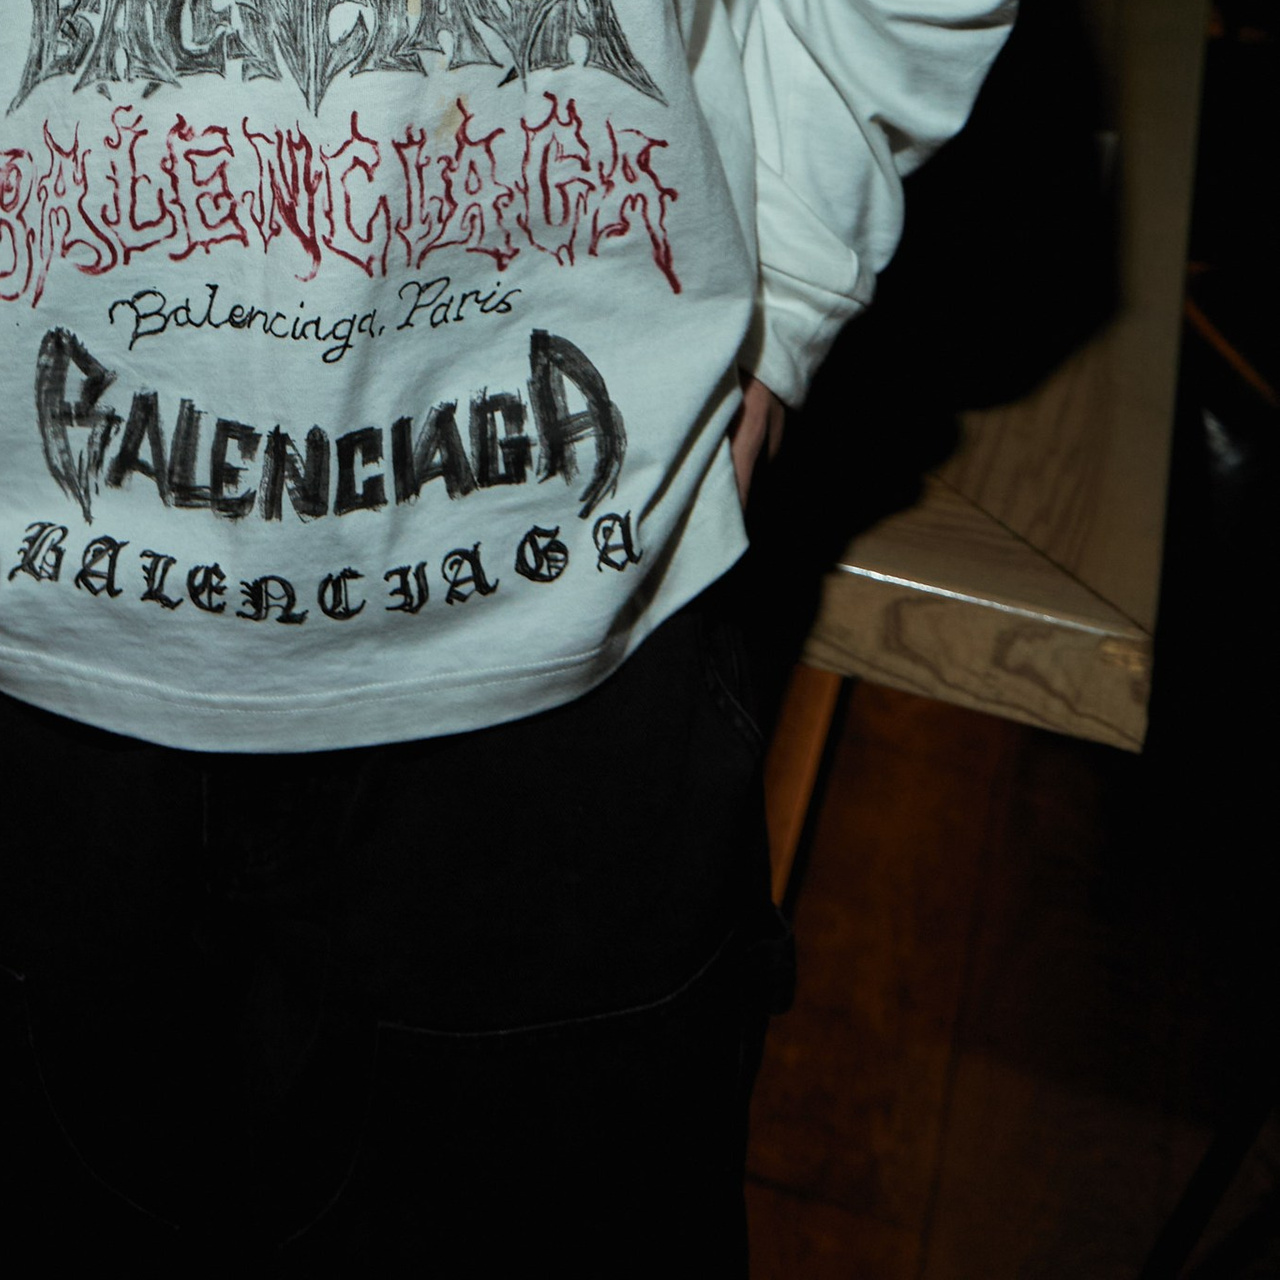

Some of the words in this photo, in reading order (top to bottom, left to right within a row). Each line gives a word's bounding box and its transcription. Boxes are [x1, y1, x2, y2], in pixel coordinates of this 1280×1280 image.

[397, 274, 523, 334] Paris
[33, 323, 629, 526] BALENCIAGA
[6, 508, 646, 626] BALENCIAGA
